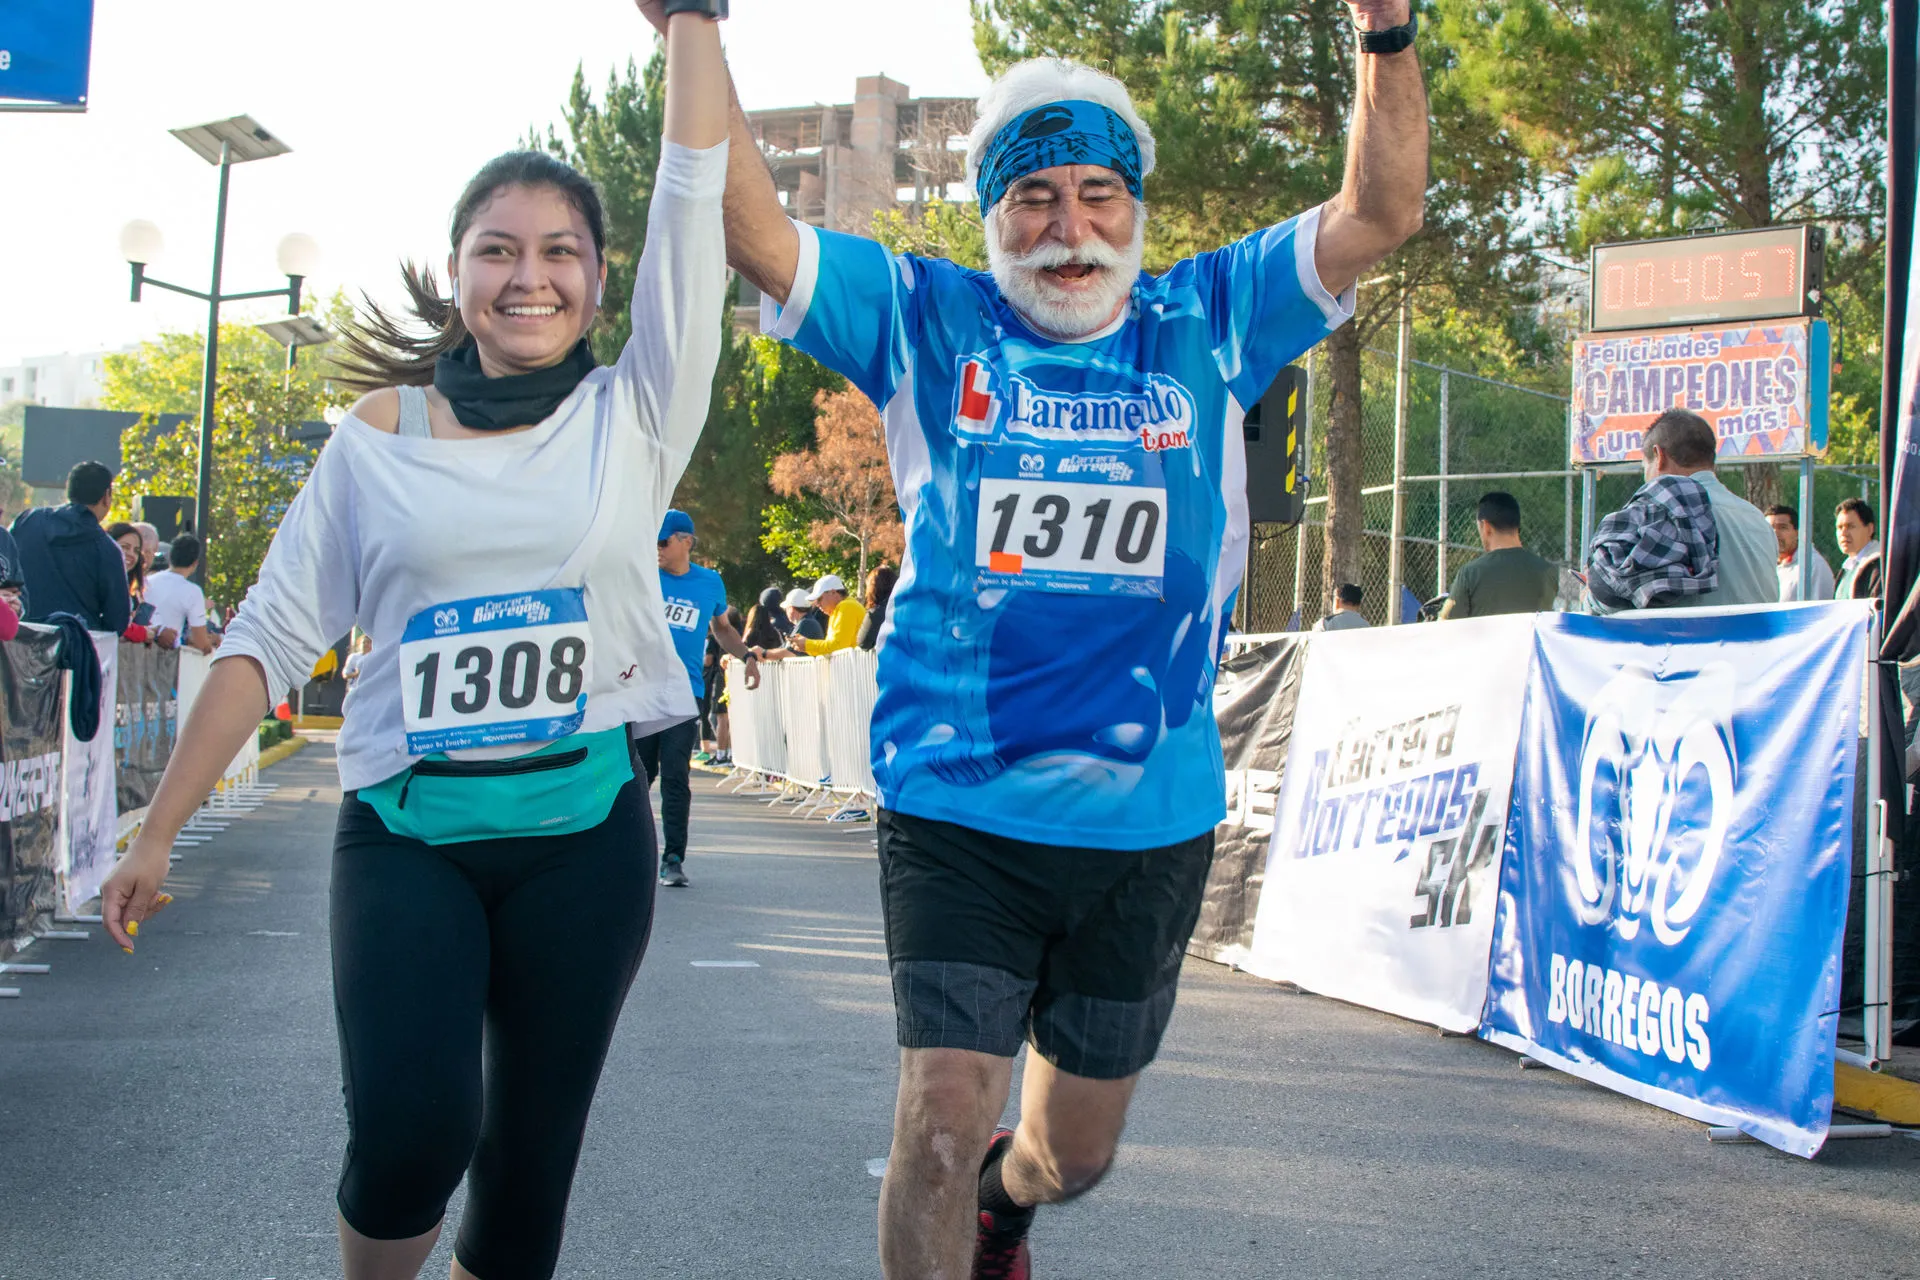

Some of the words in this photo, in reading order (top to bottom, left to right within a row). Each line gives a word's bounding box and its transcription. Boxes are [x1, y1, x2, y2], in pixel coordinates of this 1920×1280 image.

[1585, 358, 1797, 415] CAMPEONES
[1589, 339, 1720, 364] Felicidades
[990, 493, 1160, 564] 1310
[414, 636, 586, 719] 1308
[1547, 953, 1711, 1071] BORREGOS
